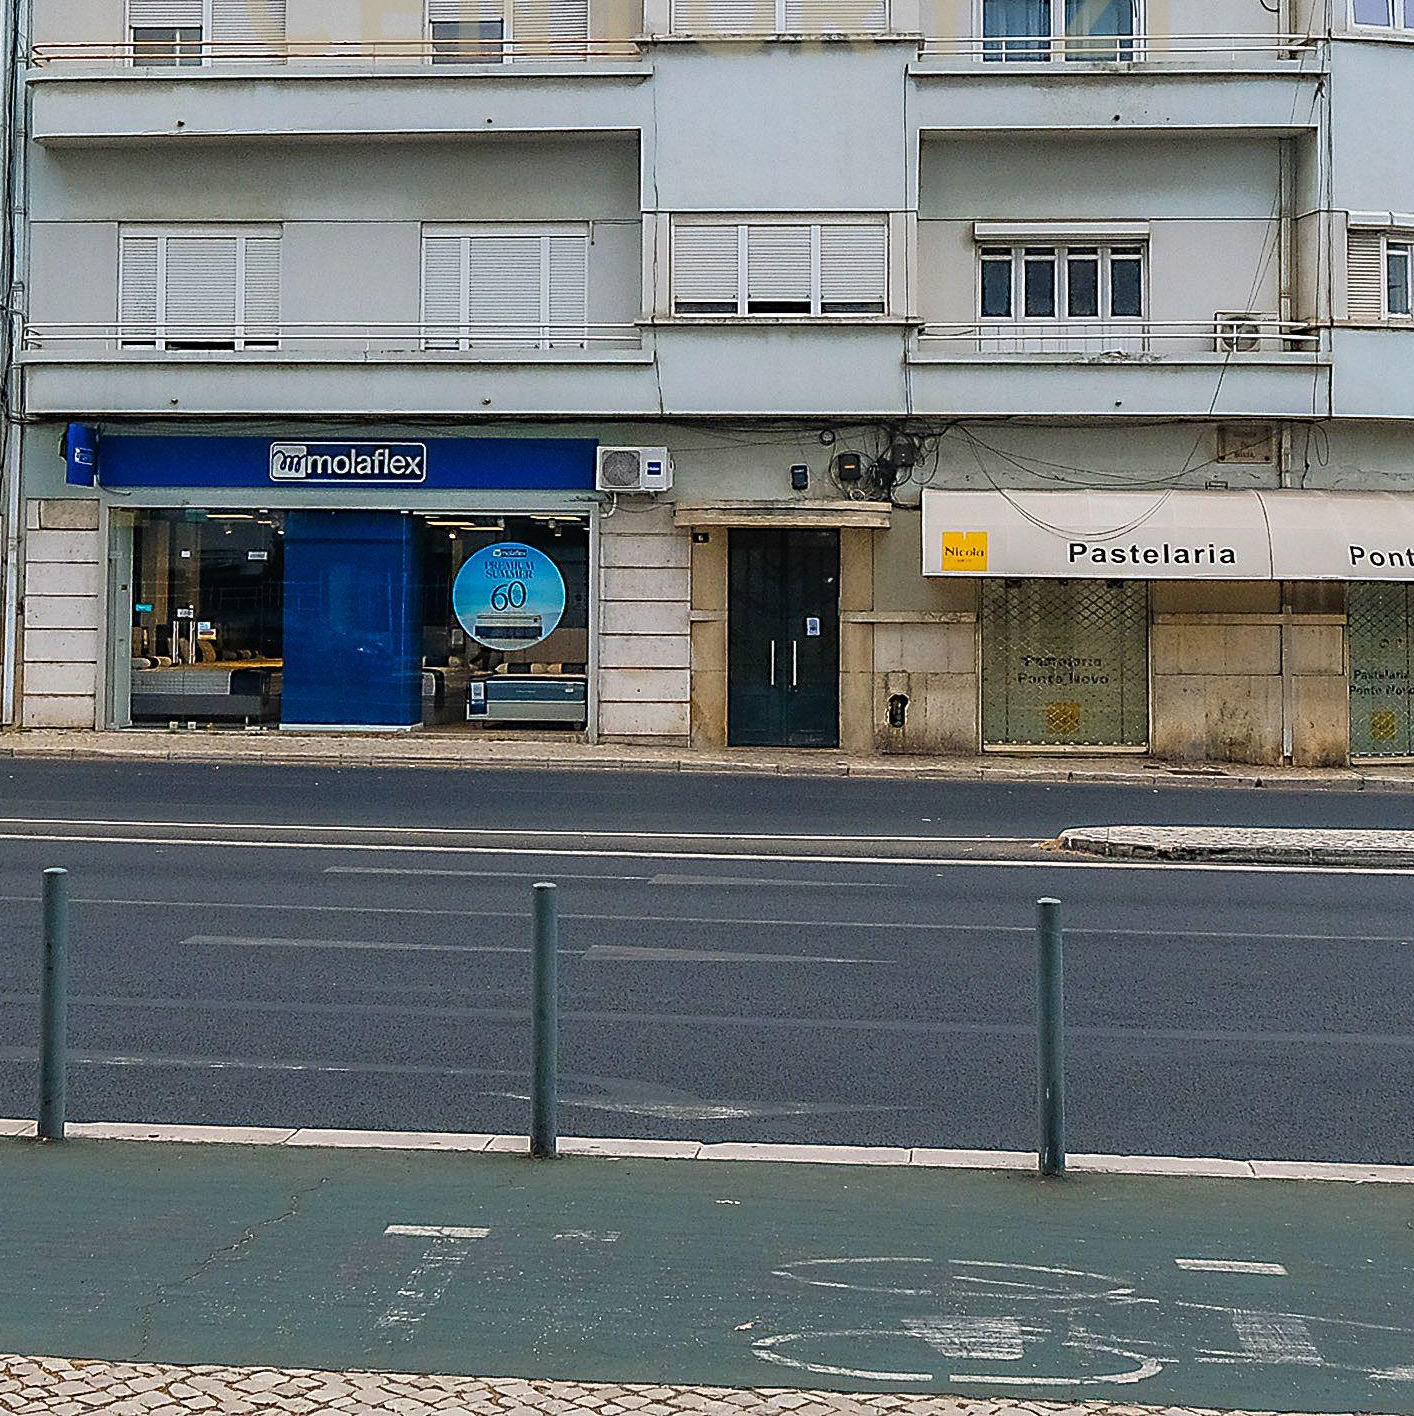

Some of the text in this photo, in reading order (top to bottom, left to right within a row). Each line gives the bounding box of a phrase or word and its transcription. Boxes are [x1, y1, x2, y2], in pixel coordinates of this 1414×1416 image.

[306, 448, 422, 476] molaflex
[1068, 542, 1237, 565] Pastelaria
[484, 569, 534, 579] SUMMER
[490, 580, 527, 612] 60
